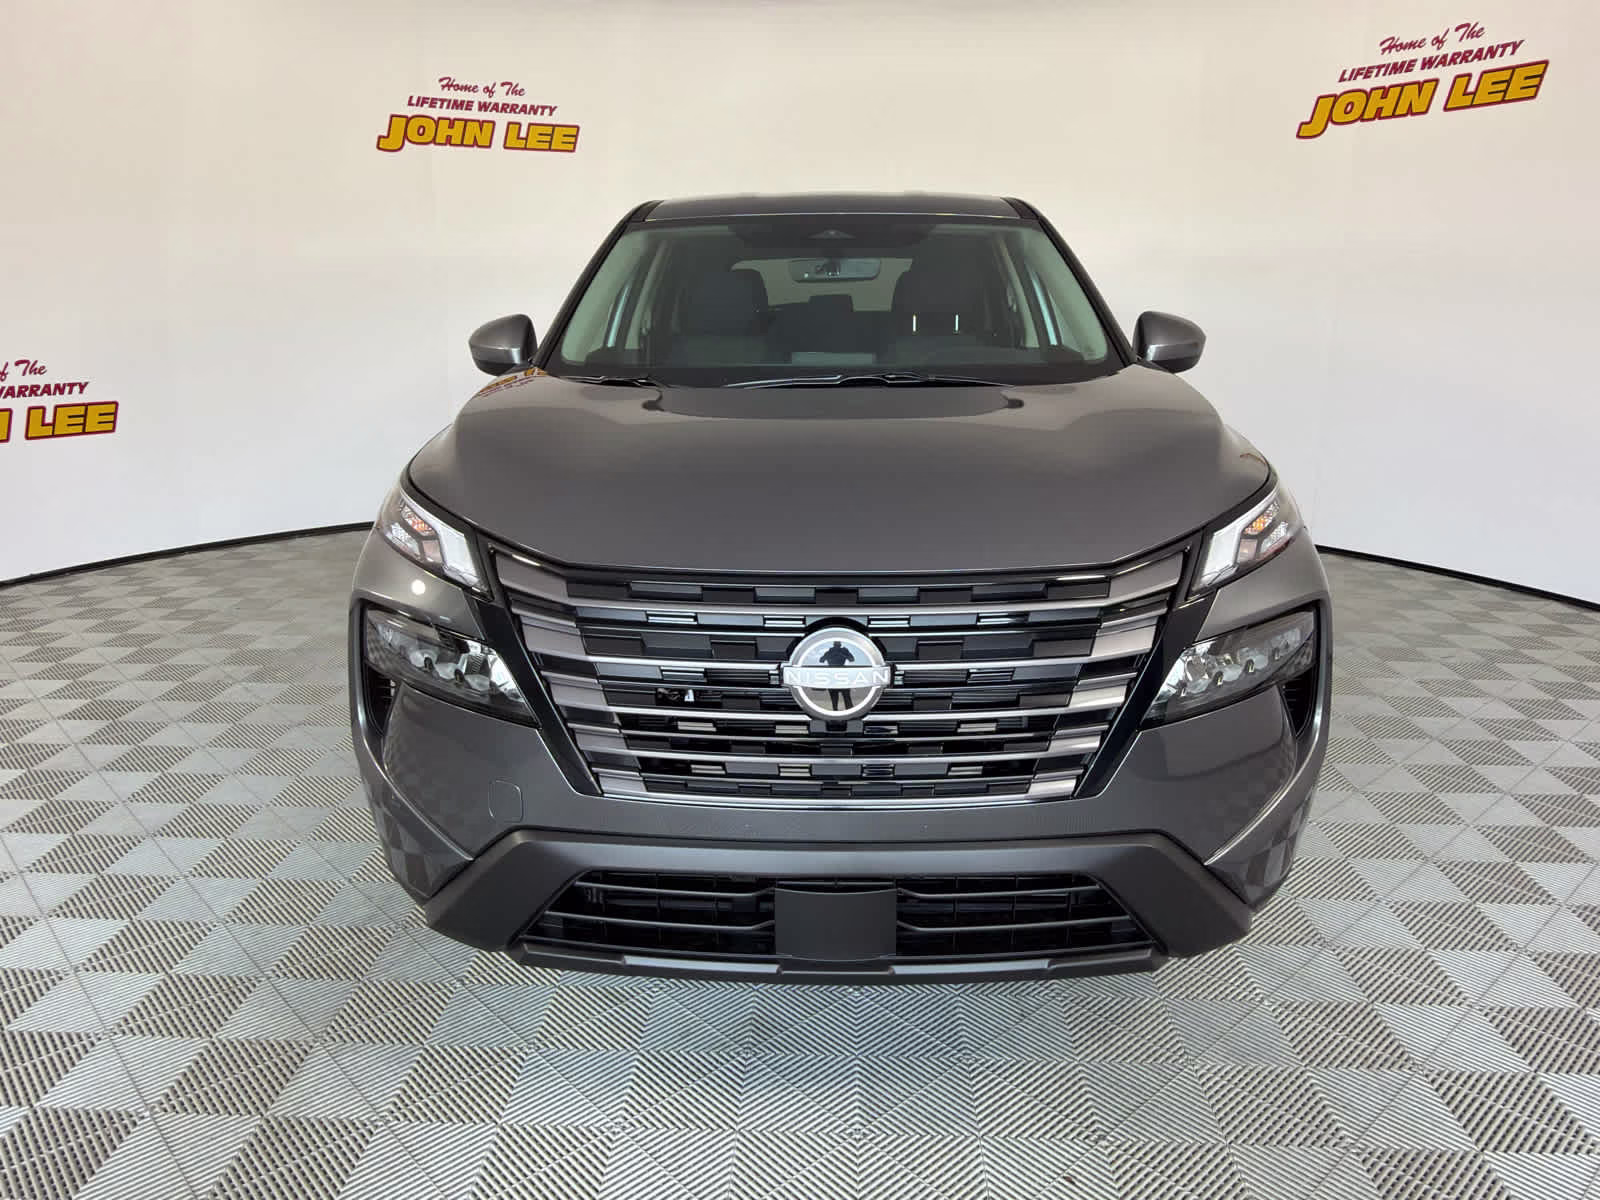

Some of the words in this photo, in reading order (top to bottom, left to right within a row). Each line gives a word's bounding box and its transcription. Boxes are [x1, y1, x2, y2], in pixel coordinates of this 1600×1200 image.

[1379, 36, 1426, 55] Home
[1431, 27, 1450, 50] of
[1454, 22, 1485, 43] The
[1338, 58, 1418, 83] LIFETIME
[1420, 39, 1525, 71] WARRANTY
[438, 77, 479, 93] Home
[482, 82, 497, 98] of
[500, 81, 526, 97] The
[1296, 78, 1440, 139] JOHN
[1443, 59, 1550, 112] LEE
[407, 95, 475, 112] LIFETIME
[477, 100, 558, 117] WARRANTY
[376, 113, 496, 152] JOHN
[503, 121, 580, 153] LEE
[14, 359, 47, 377] The
[24, 400, 119, 441] LEE
[785, 669, 889, 685] NISSAN
